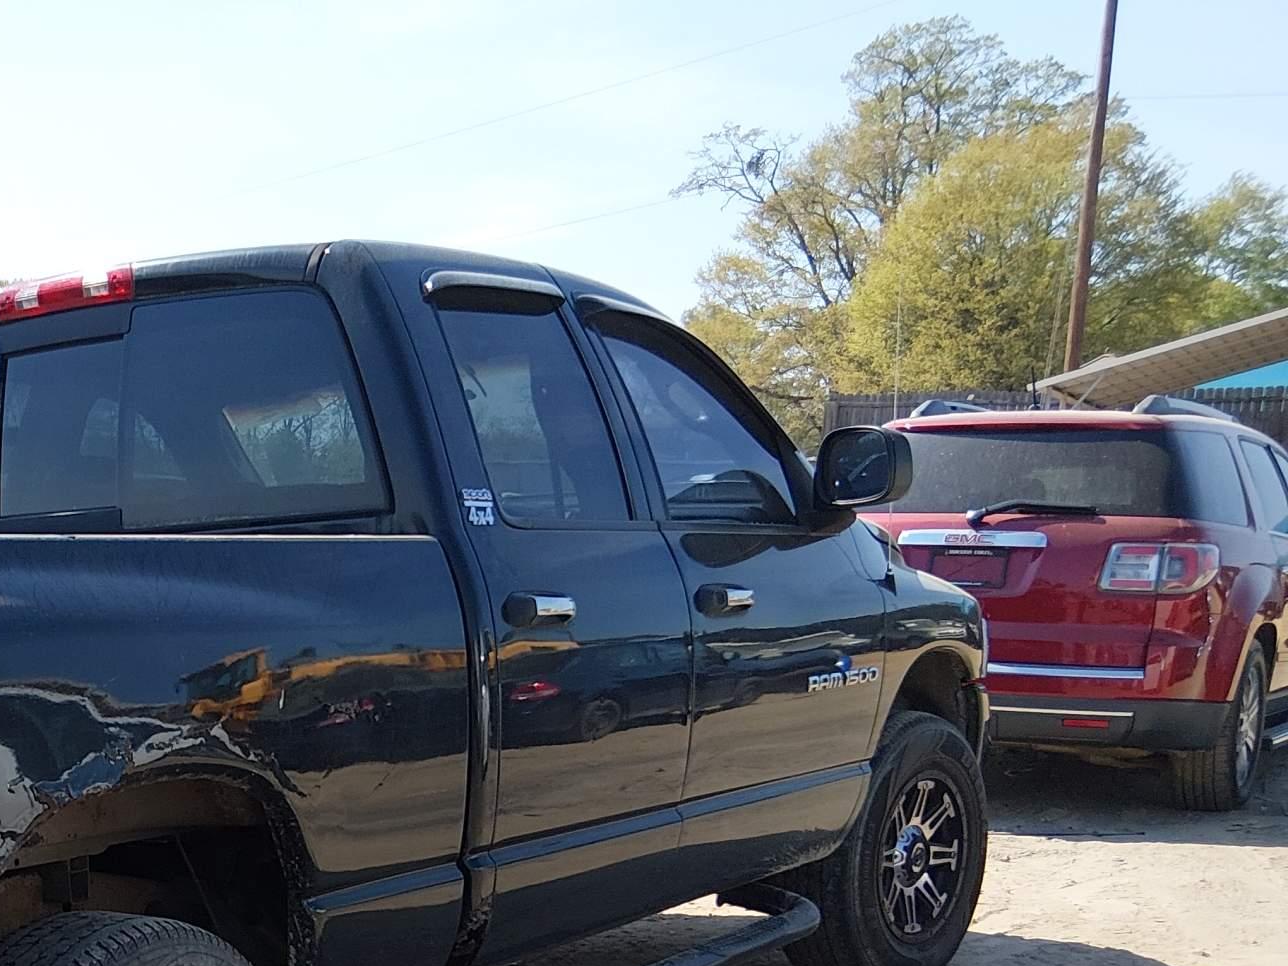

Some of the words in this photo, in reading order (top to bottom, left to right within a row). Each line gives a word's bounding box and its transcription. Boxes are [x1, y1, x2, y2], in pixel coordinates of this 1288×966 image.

[469, 506, 494, 526] 4x4
[944, 533, 996, 545] GMC
[808, 672, 843, 693] RAM
[845, 667, 879, 686] 1500
